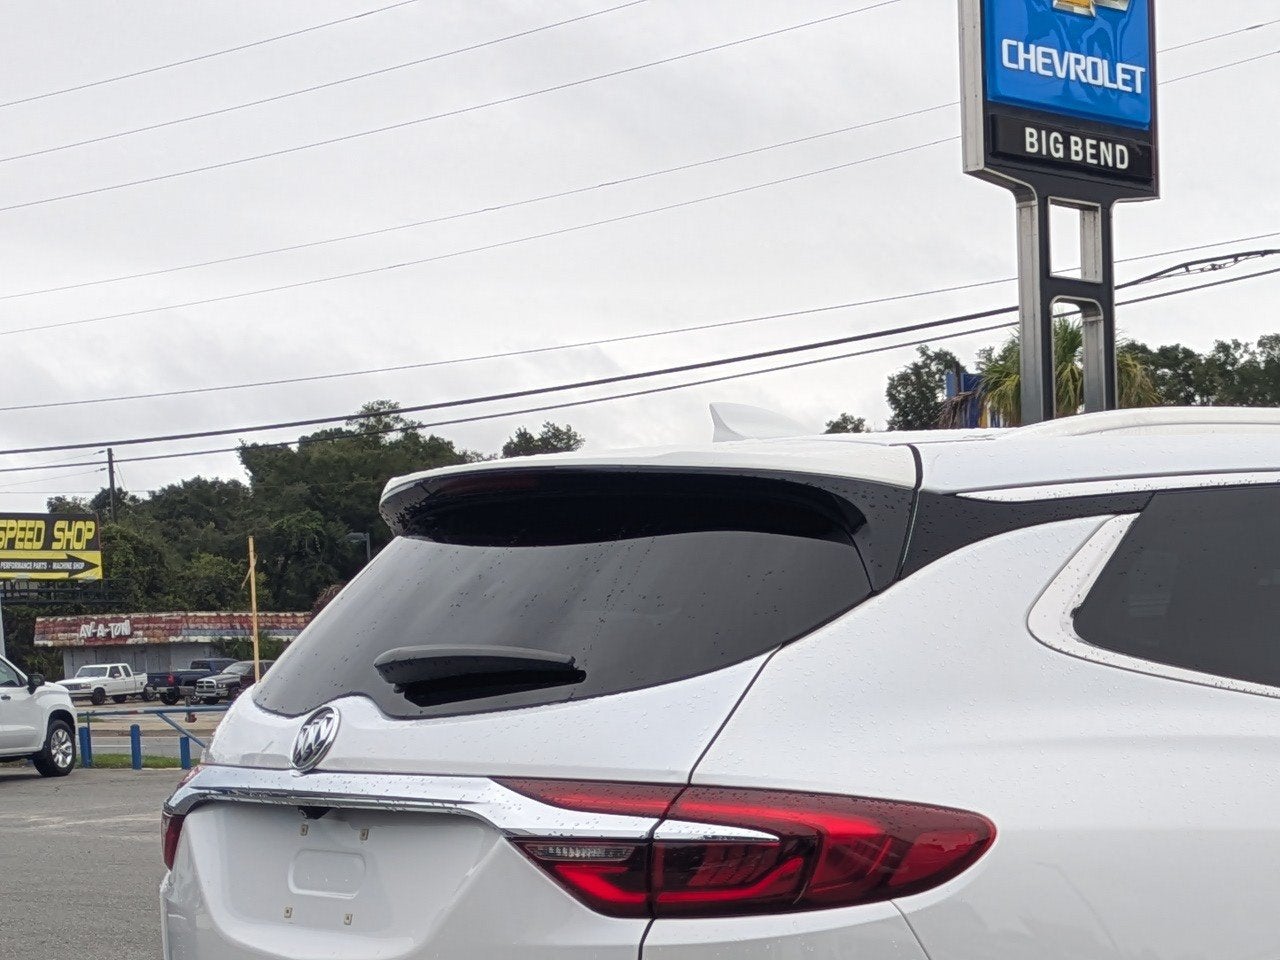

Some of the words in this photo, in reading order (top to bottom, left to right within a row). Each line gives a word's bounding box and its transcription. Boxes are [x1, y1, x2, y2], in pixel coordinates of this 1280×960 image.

[1002, 38, 1146, 94] CHEVROLET
[1025, 126, 1064, 159] BIG
[1069, 135, 1129, 170] BEND
[51, 520, 96, 550] SHOP
